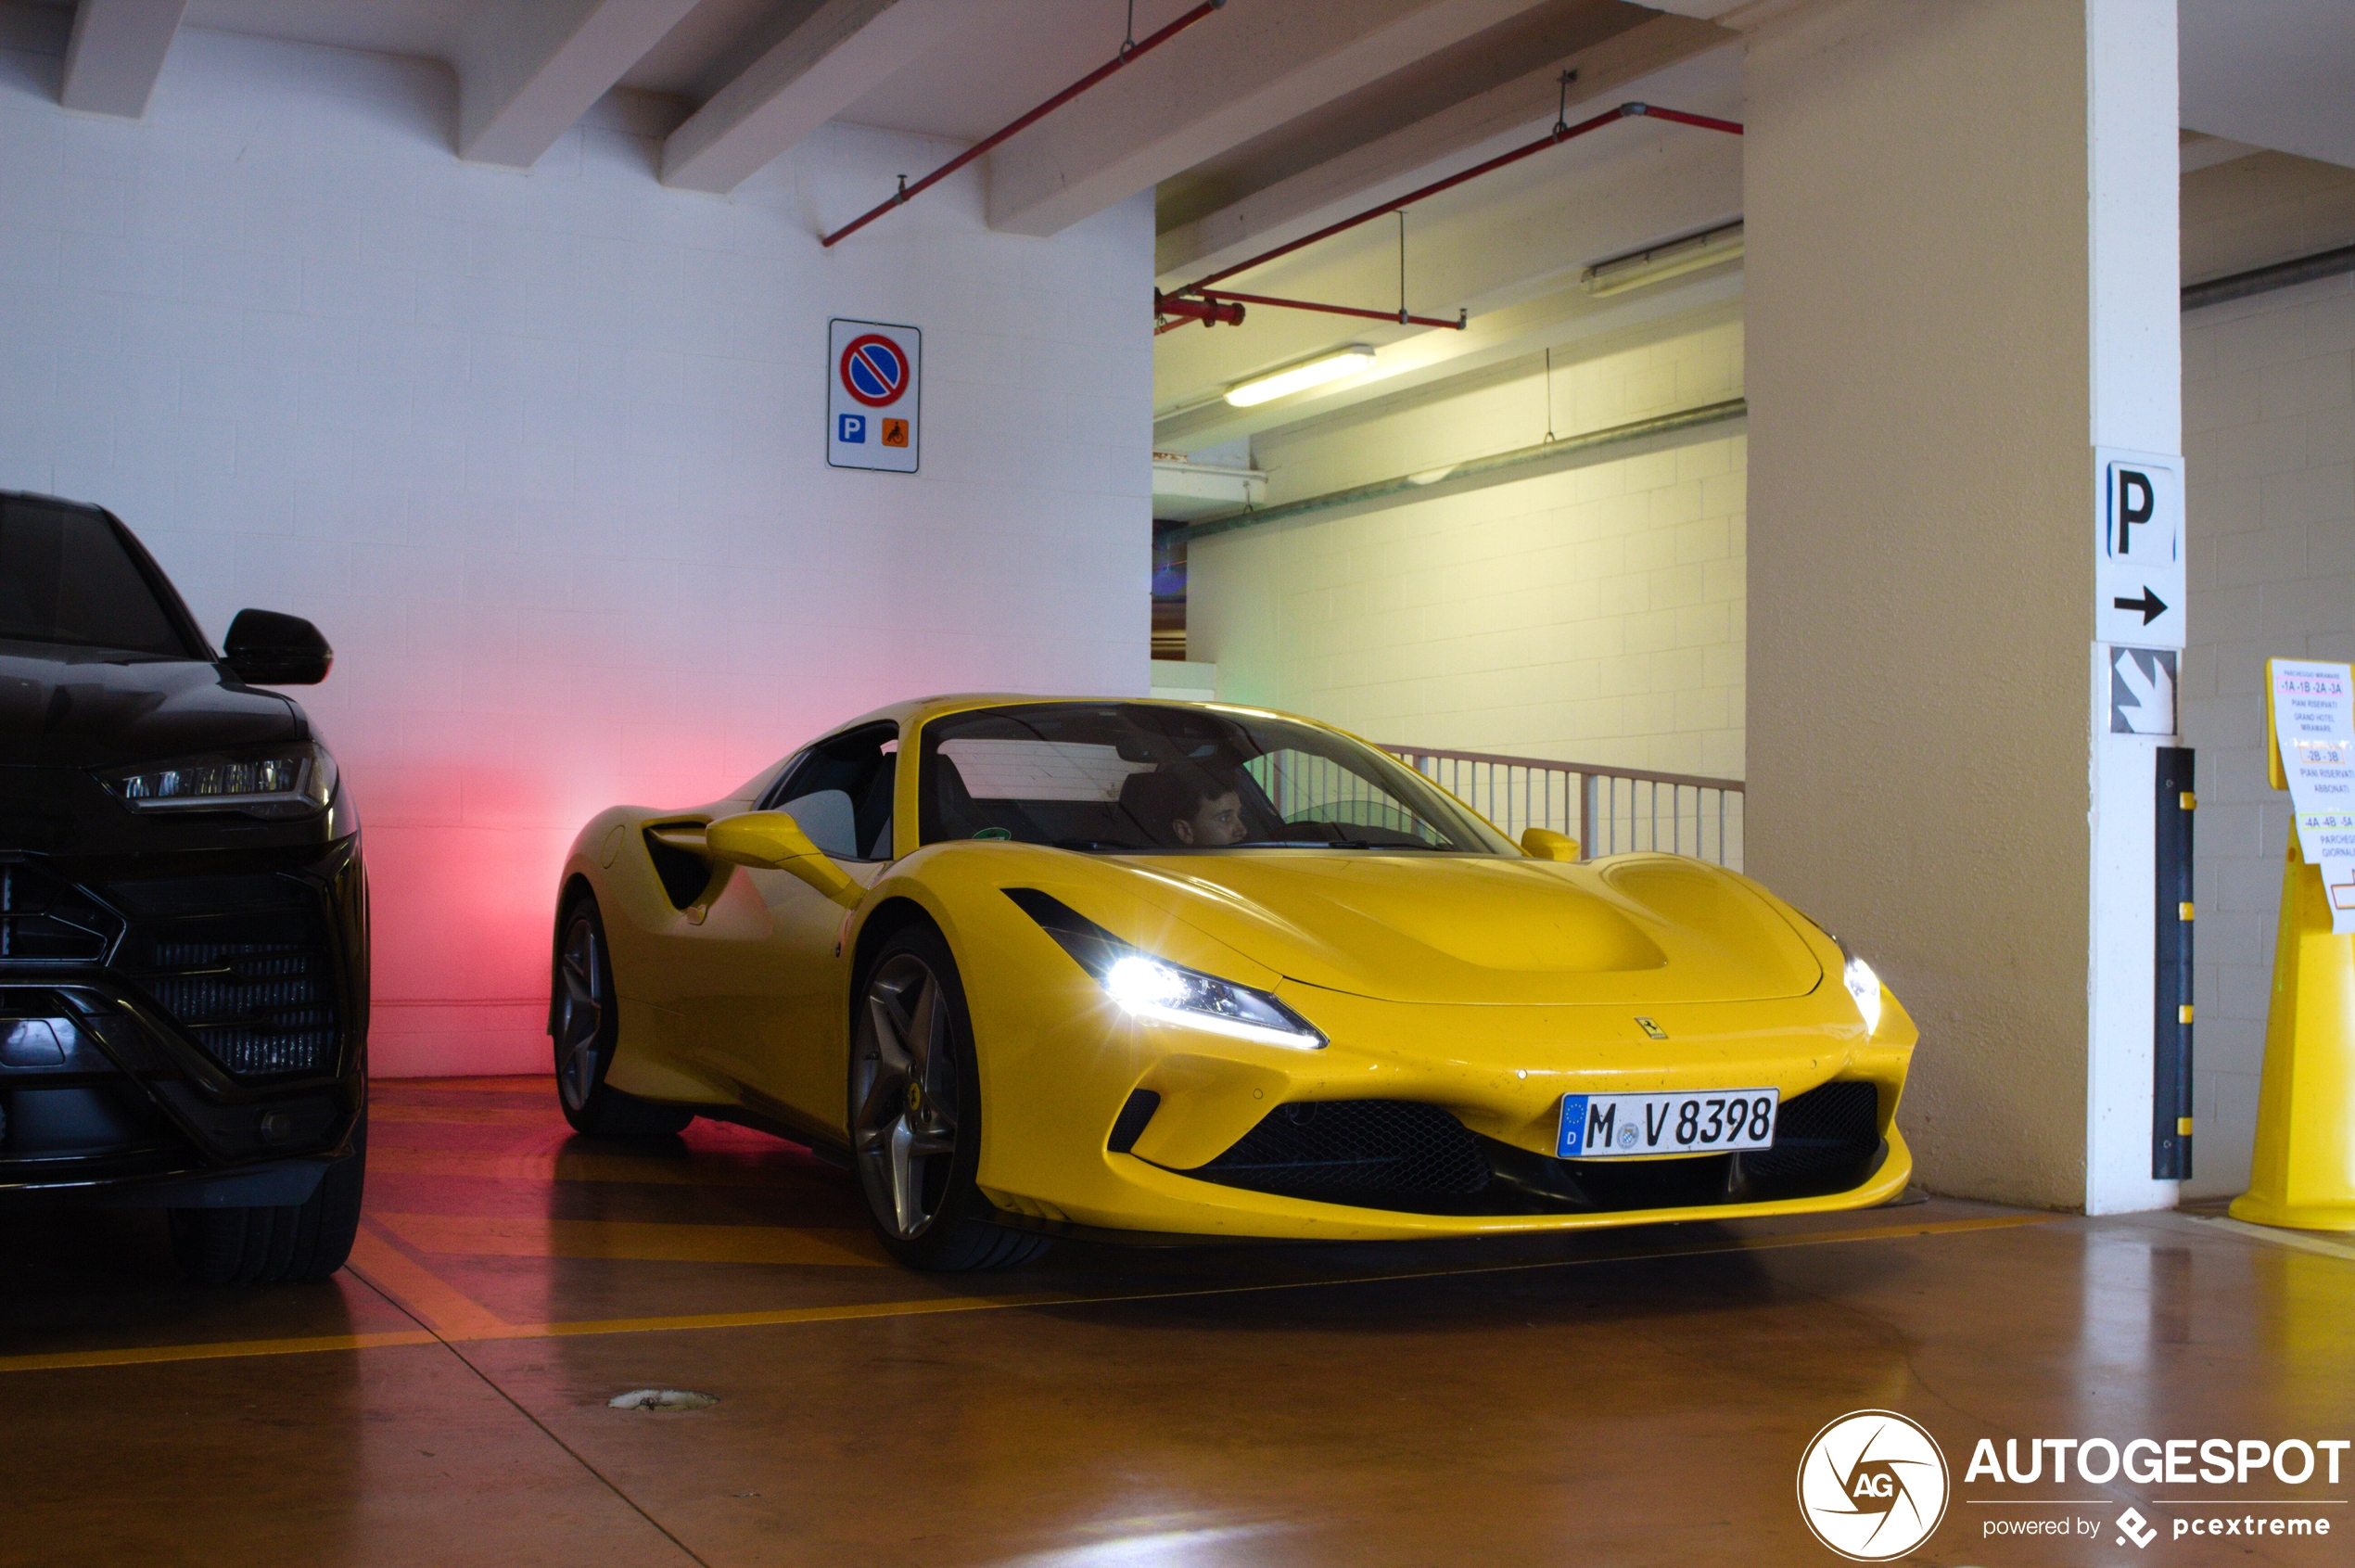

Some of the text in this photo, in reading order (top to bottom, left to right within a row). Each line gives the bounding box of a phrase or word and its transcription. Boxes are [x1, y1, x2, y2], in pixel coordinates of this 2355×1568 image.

[845, 418, 861, 440] P
[2118, 469, 2155, 555] P
[2291, 698, 2337, 709] PIANI RISERVATI
[2294, 712, 2336, 723] GRAND HOTEL
[2300, 768, 2318, 778] PIANI
[2314, 784, 2350, 794] ABBONATI
[1585, 1103, 1617, 1149] M
[1674, 1097, 1772, 1145] 8398
[1566, 1131, 1577, 1145] D
